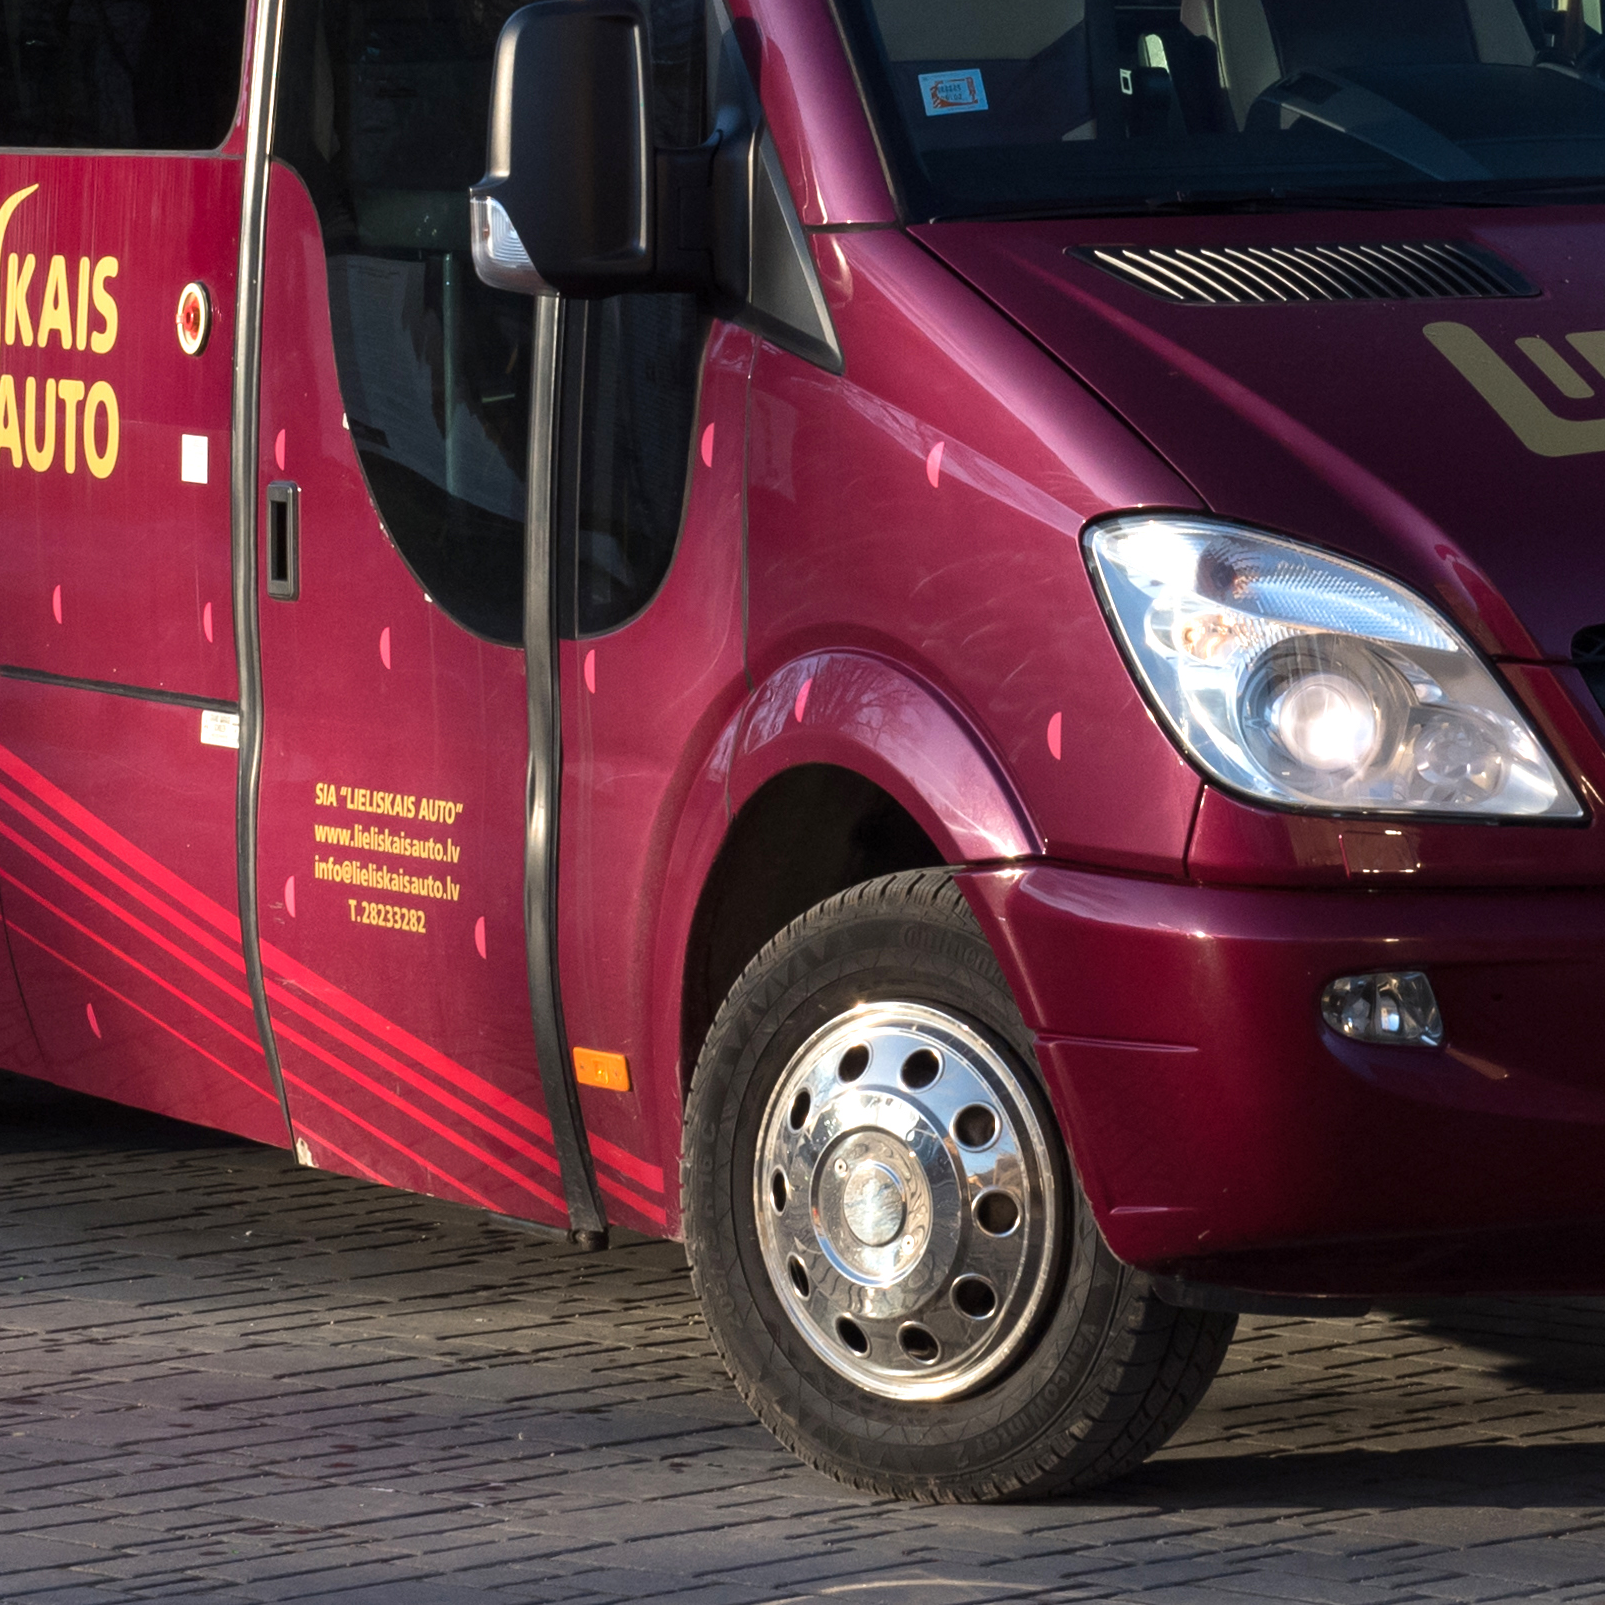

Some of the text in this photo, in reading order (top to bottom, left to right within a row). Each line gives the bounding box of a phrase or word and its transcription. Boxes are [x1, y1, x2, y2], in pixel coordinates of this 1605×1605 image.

[314, 782, 464, 825] SIA "LIELISKAIS AUTO"
[314, 823, 461, 864] www.lieliskaisauto.lv
[314, 854, 461, 902] info@lieliskaisauto.lv
